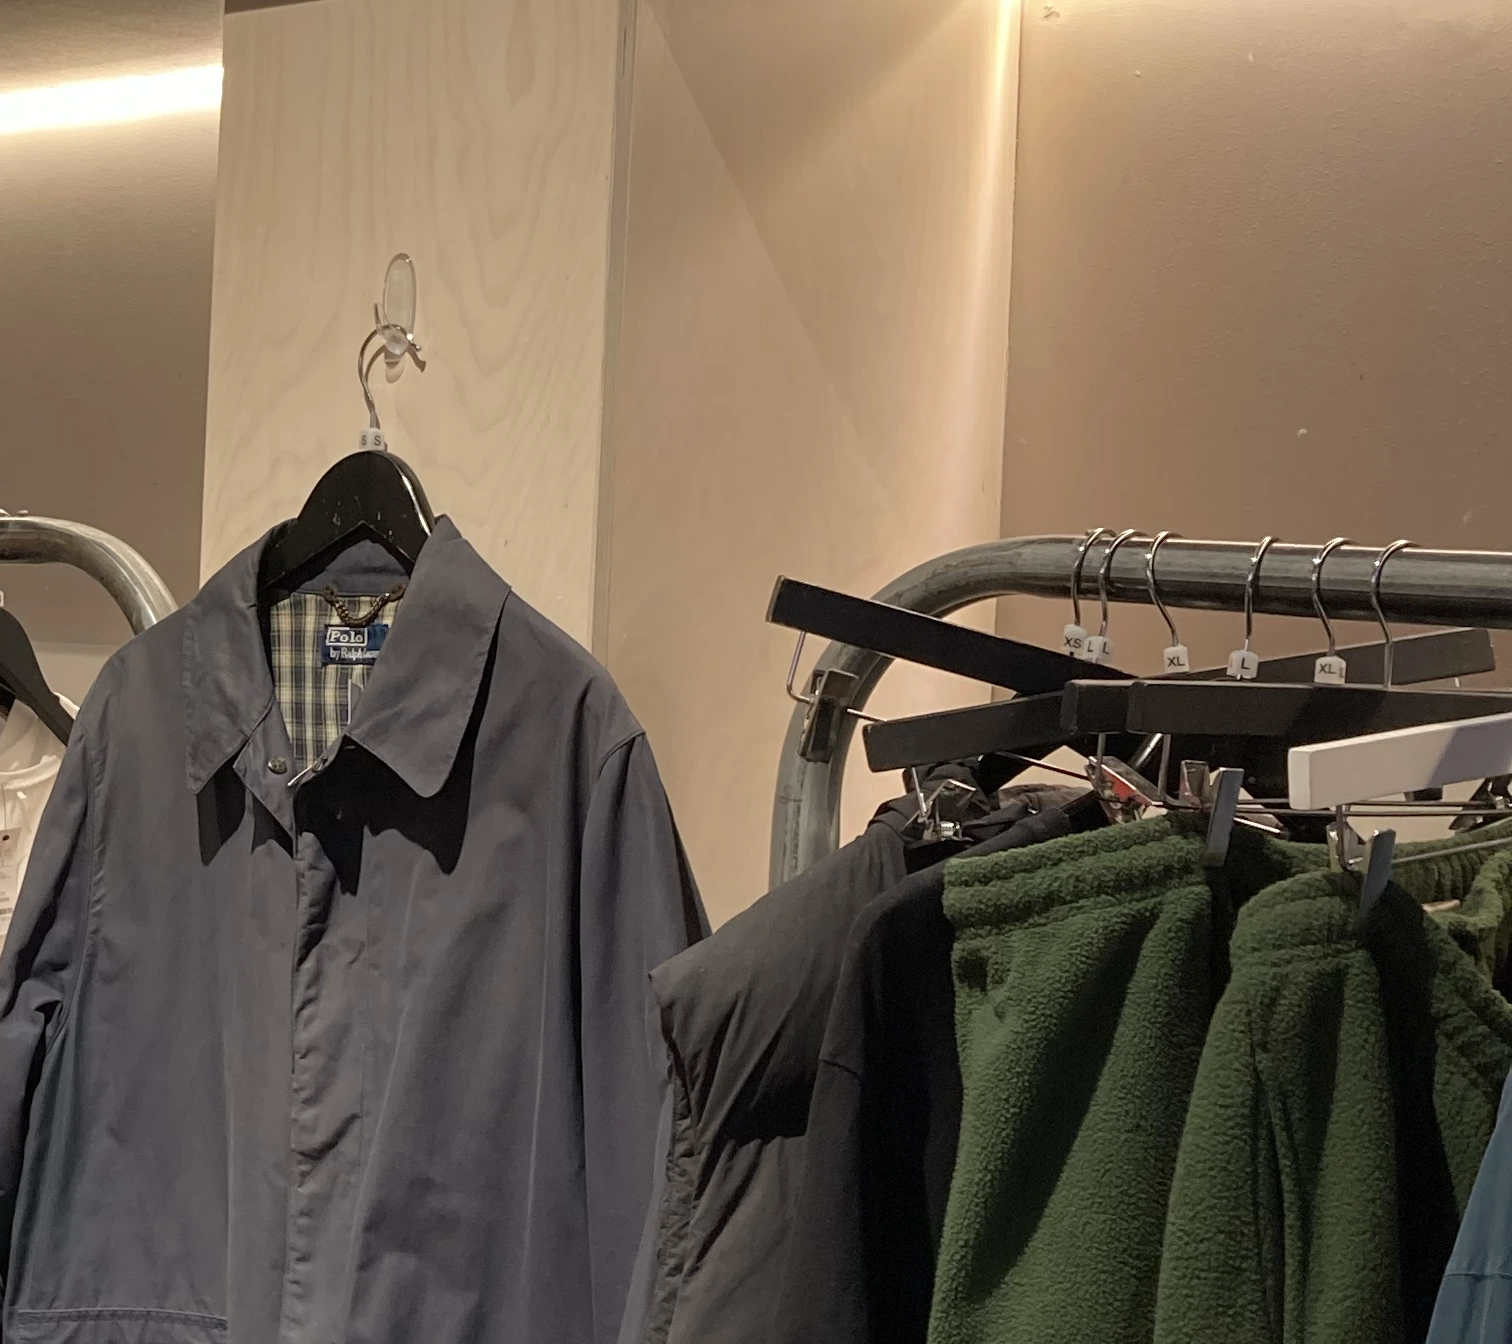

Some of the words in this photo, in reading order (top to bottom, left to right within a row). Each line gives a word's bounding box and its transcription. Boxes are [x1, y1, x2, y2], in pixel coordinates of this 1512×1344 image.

[329, 631, 364, 643] Polo
[1064, 636, 1082, 649] XS
[329, 647, 340, 661] by
[1087, 640, 1094, 652] L
[1102, 641, 1110, 655] L
[1167, 656, 1186, 667] XL
[1241, 657, 1250, 670] L
[1318, 663, 1337, 674] XL
